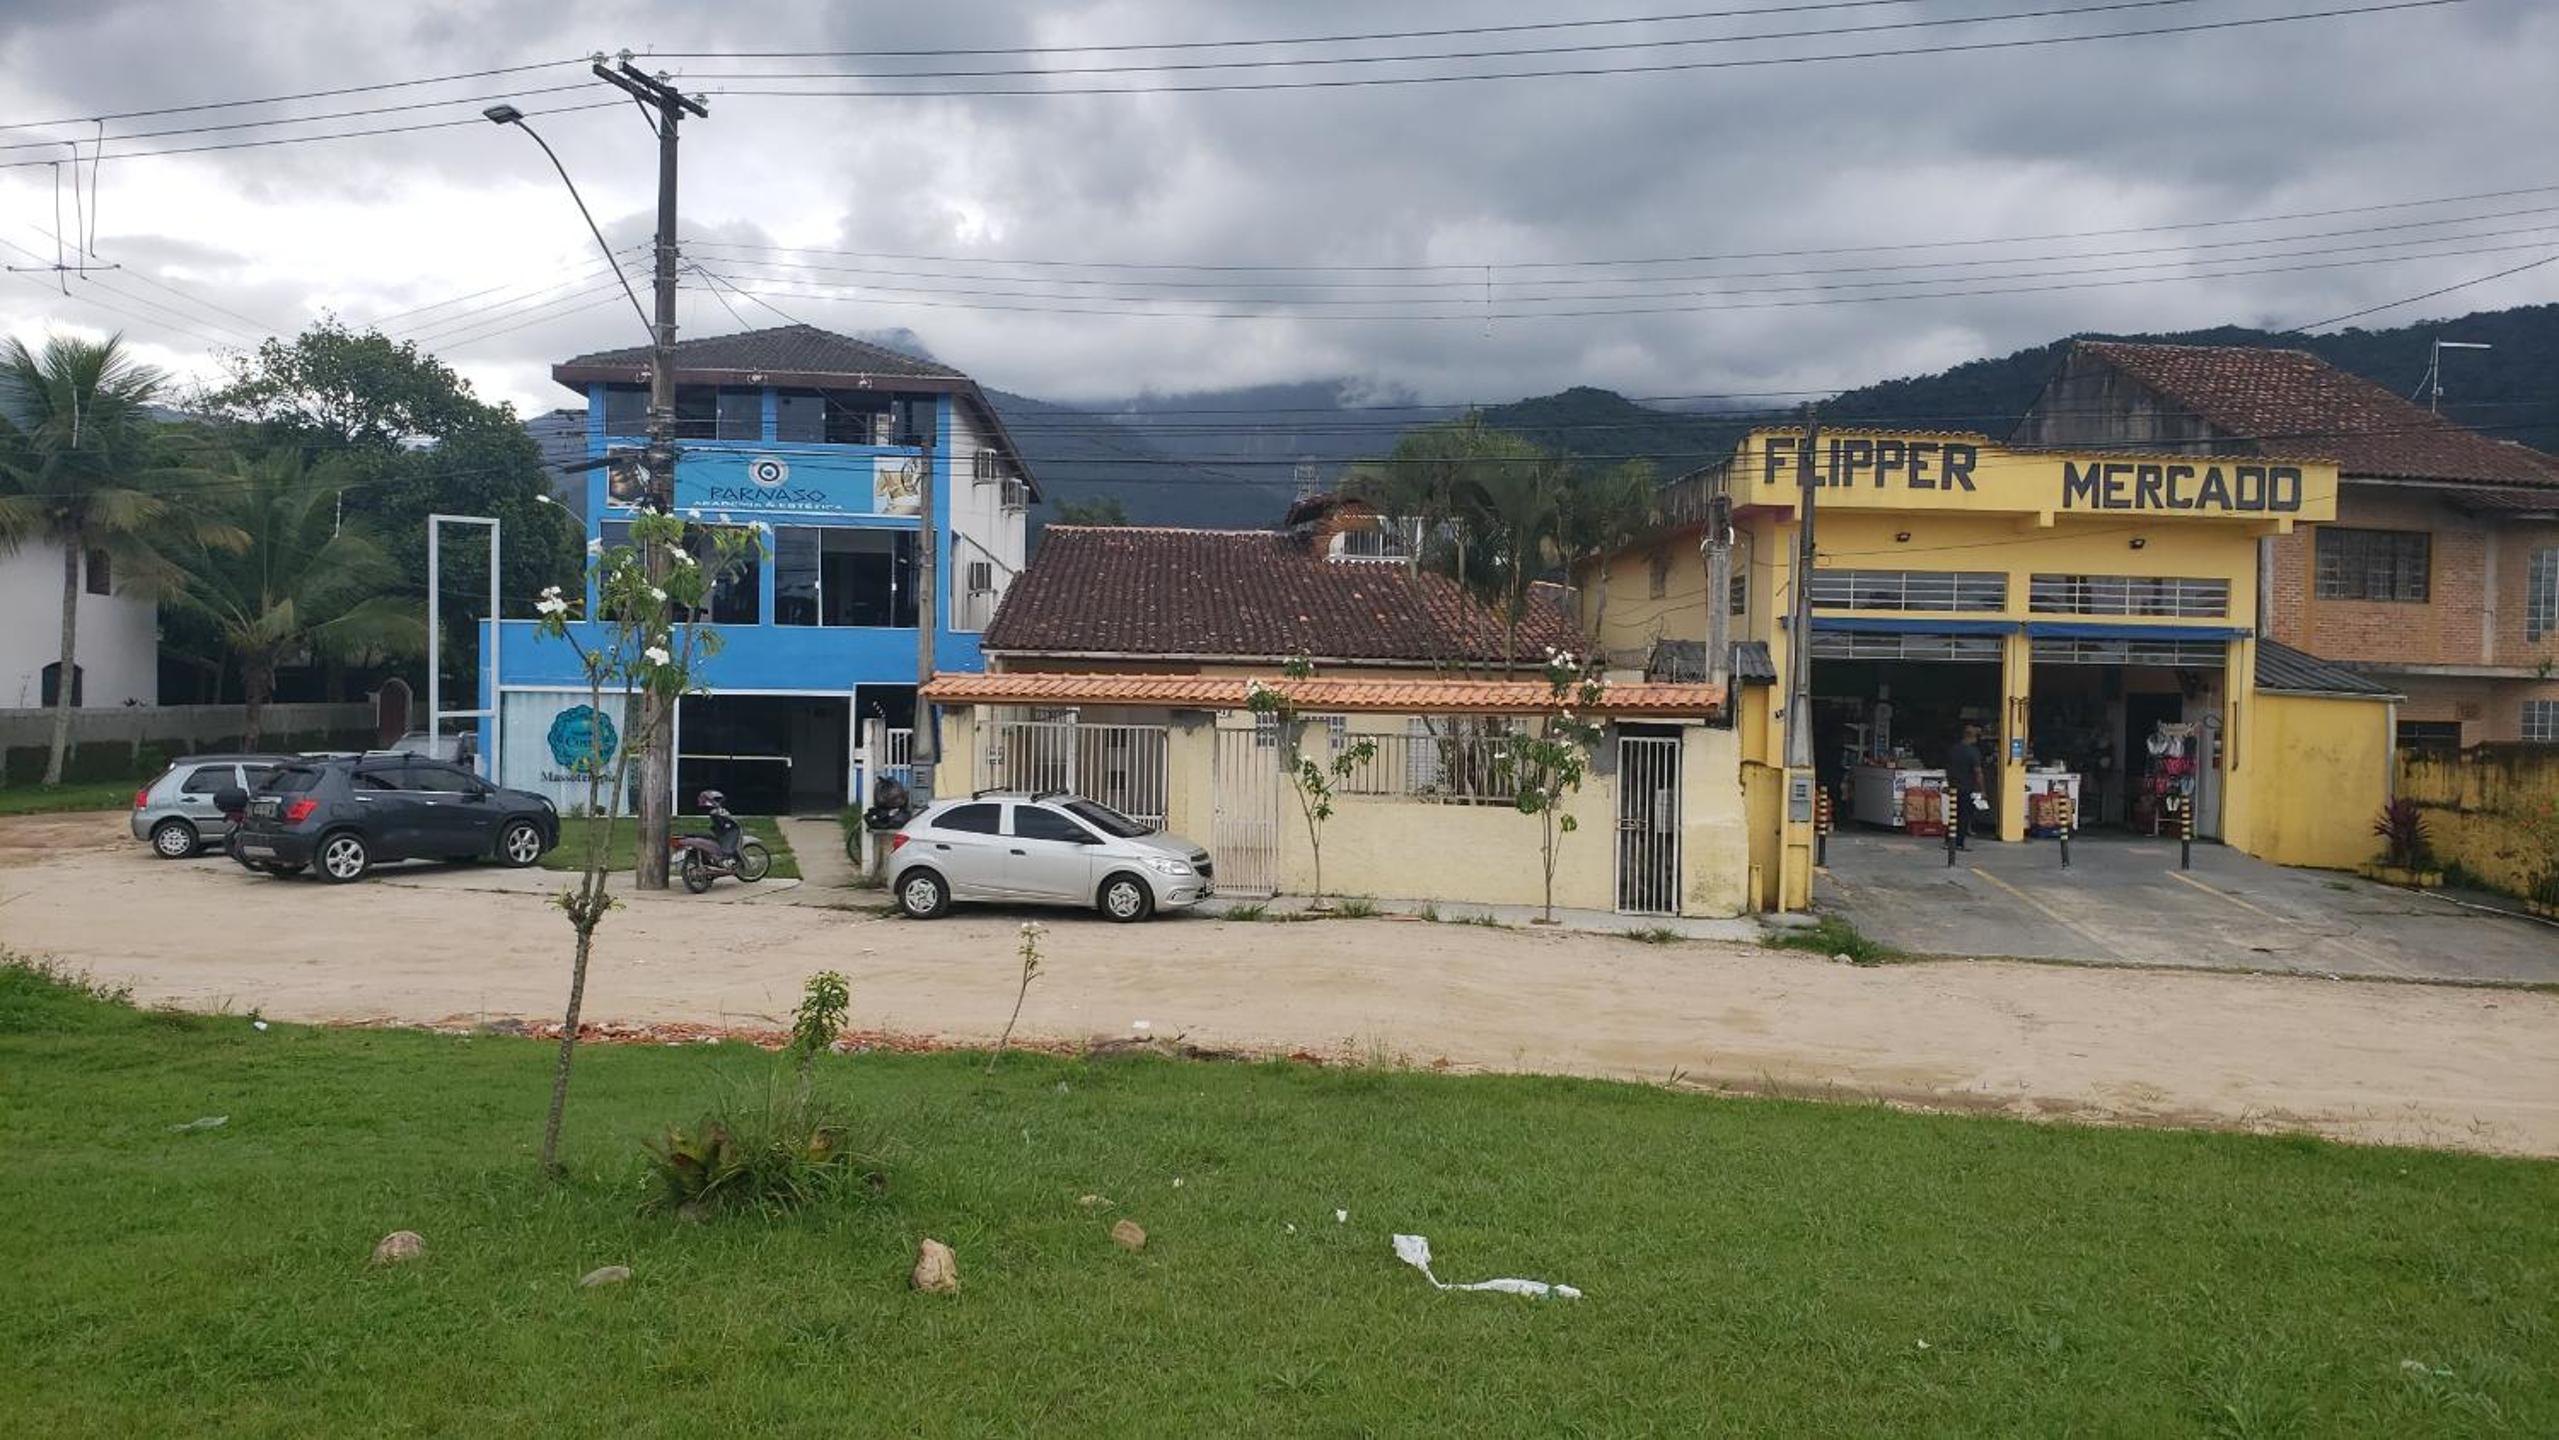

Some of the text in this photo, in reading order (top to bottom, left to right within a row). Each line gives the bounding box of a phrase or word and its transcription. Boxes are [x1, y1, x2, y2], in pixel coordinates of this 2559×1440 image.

[710, 486, 827, 503] PARNASO
[1764, 437, 2302, 512] FLIPPER MERCADO
